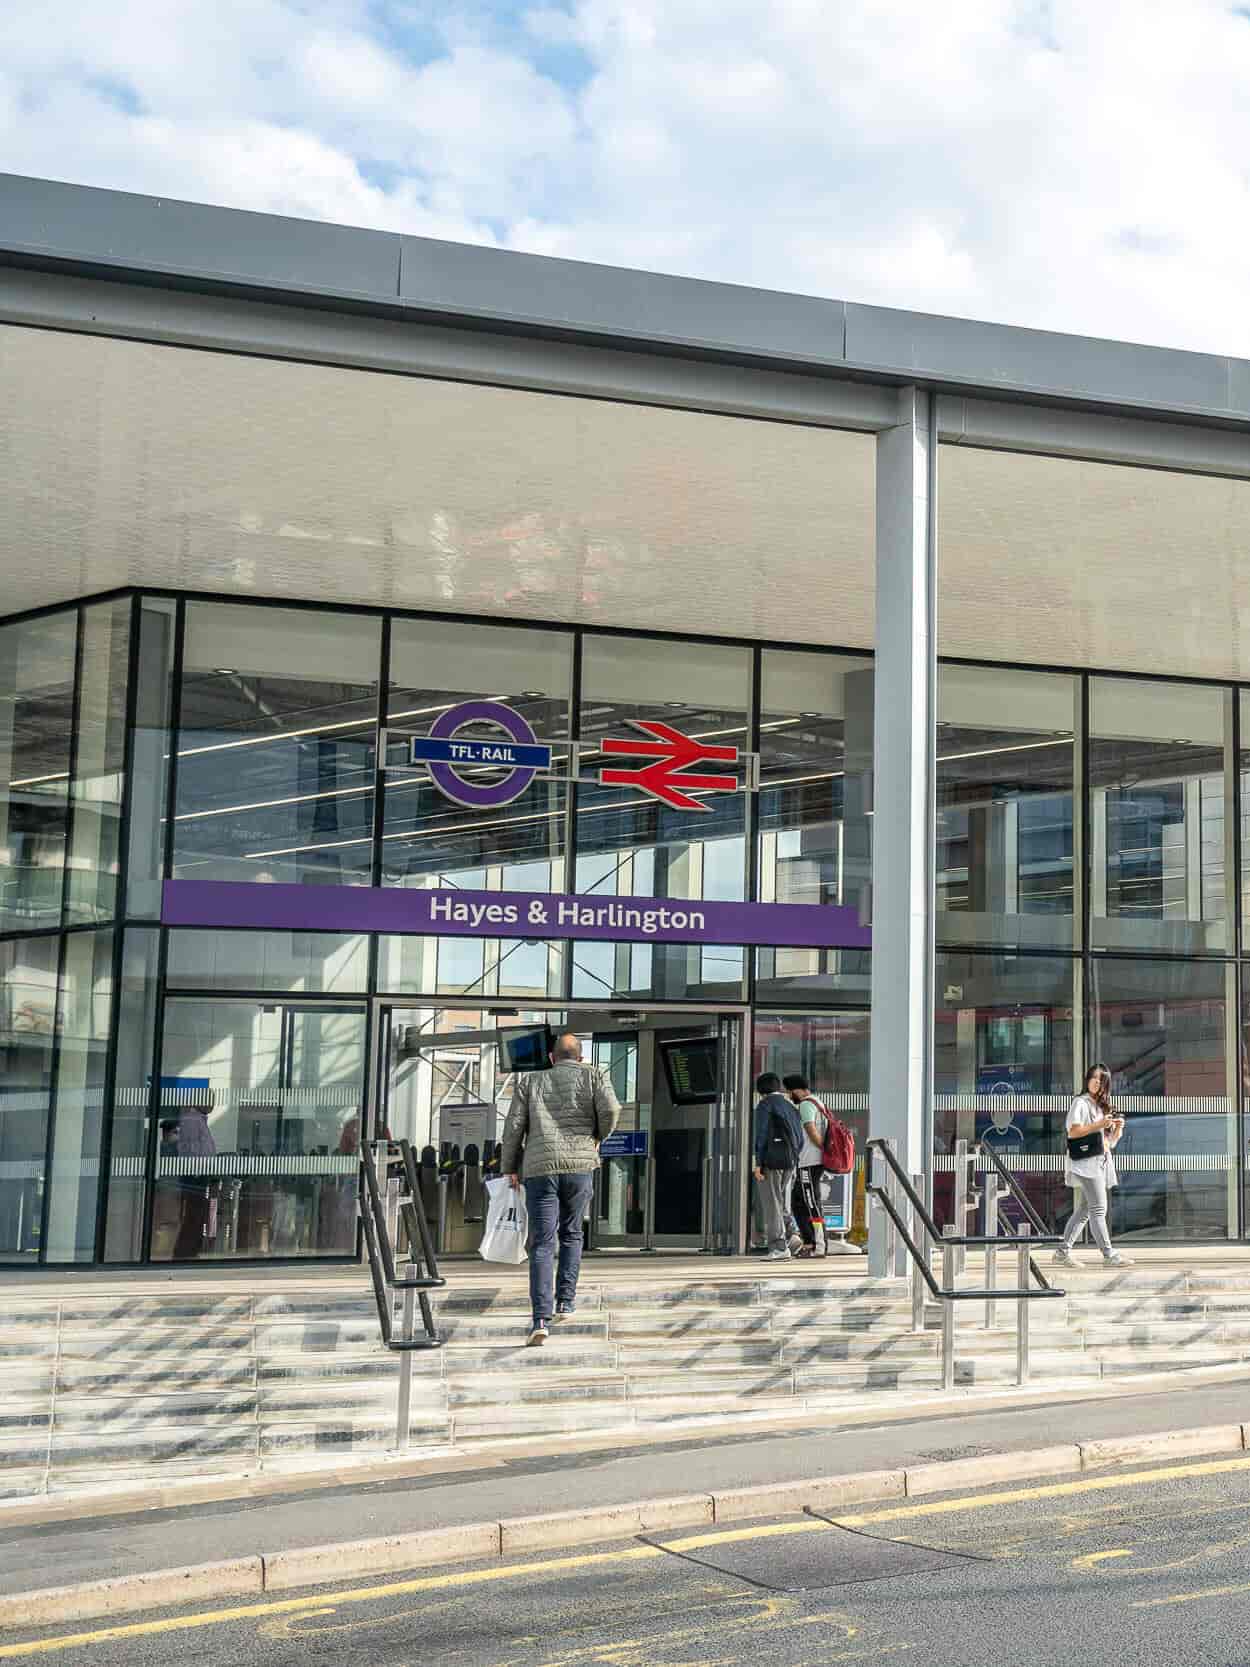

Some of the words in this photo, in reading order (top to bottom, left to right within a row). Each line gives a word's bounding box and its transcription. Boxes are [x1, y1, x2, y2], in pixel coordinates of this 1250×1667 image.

[430, 896, 518, 927] Hayes
[527, 900, 549, 924] &
[558, 902, 705, 933] Harlington
